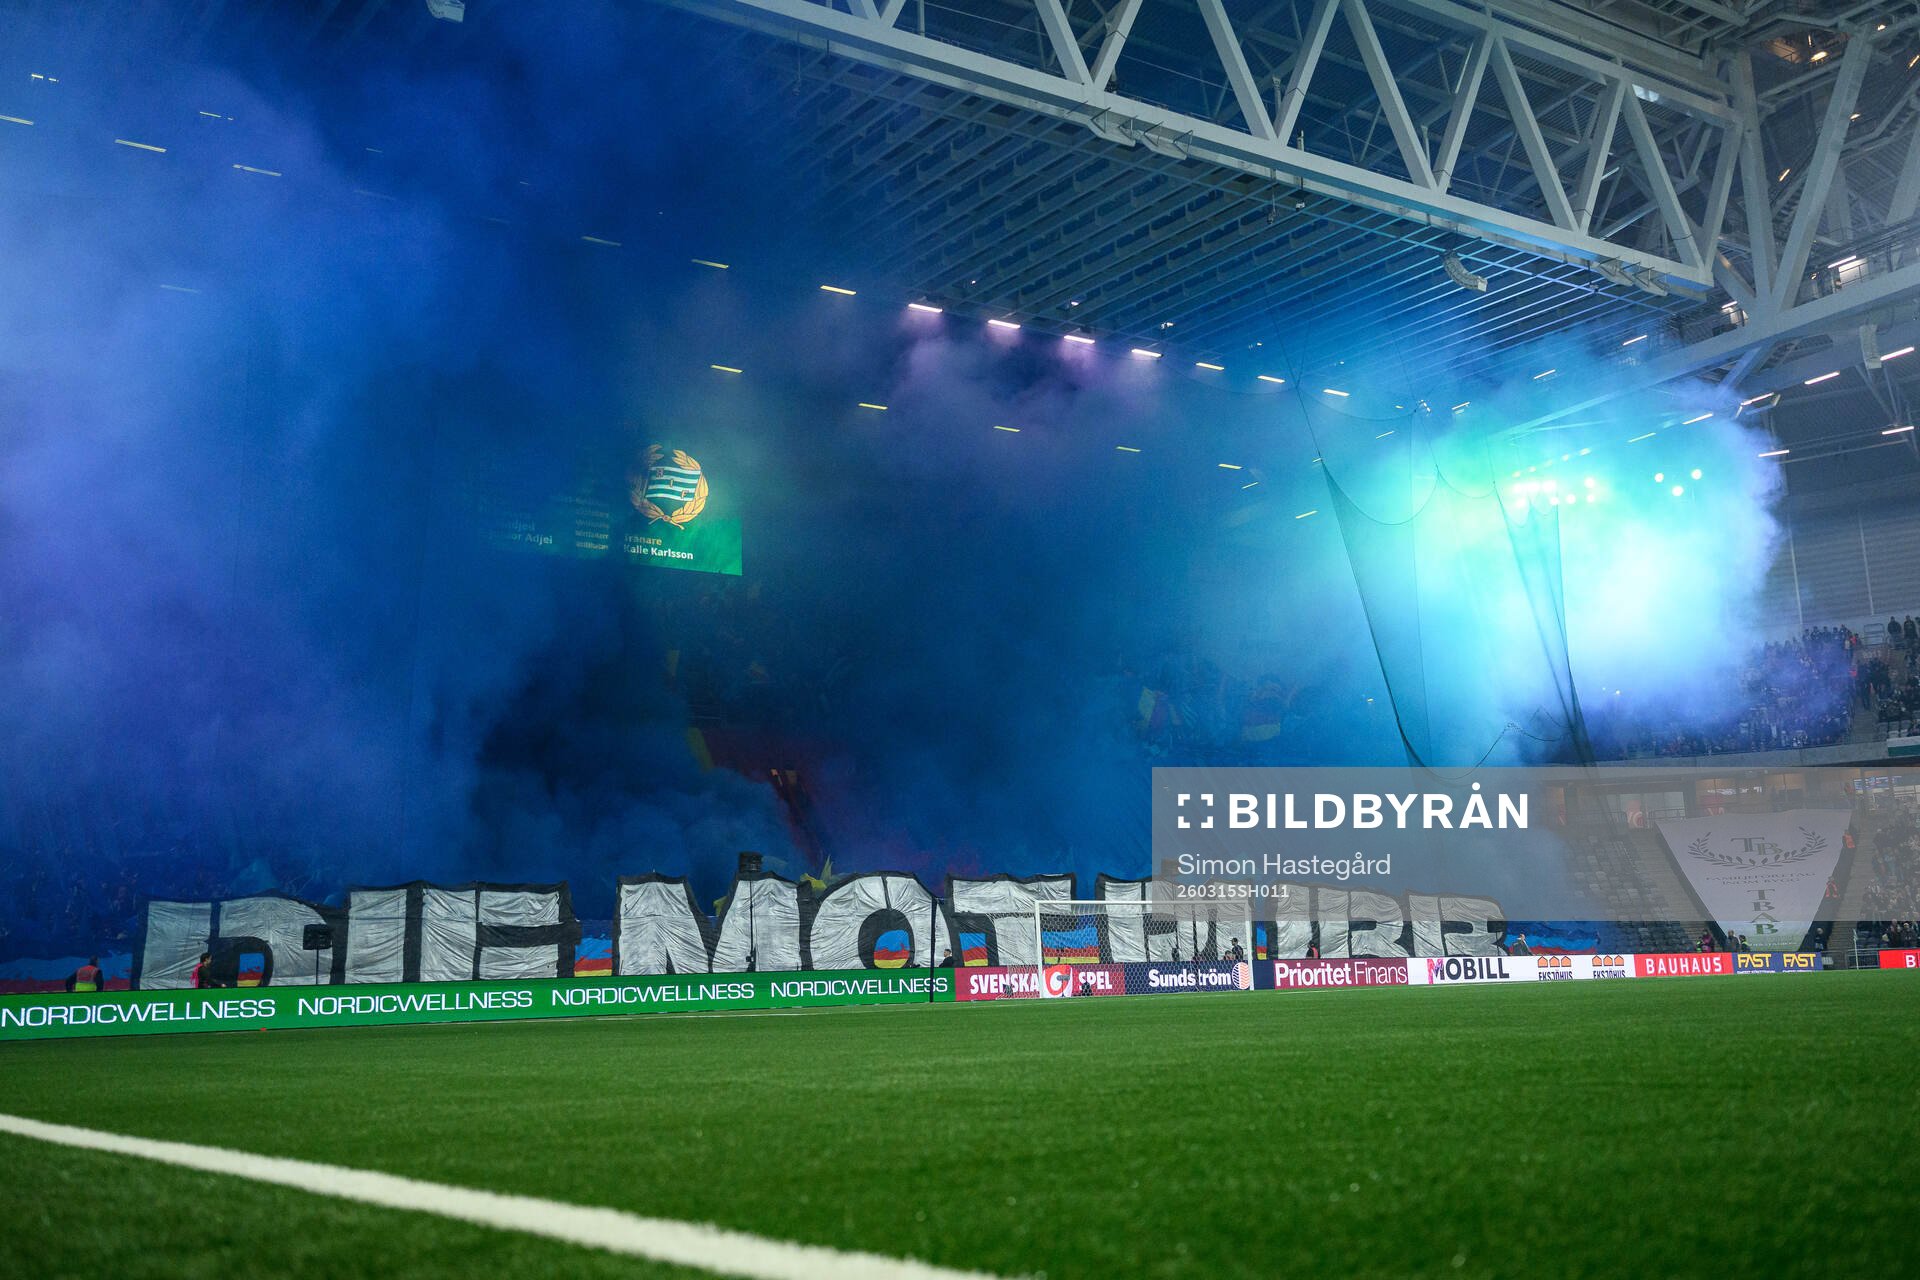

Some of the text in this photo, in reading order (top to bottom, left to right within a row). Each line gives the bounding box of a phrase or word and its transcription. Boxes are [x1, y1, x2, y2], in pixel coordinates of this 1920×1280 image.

[651, 547, 694, 560] Karlsson
[1645, 956, 1723, 974] BAUHAUS
[1737, 953, 1772, 968] FAST
[1783, 953, 1816, 968] FAST
[1148, 968, 1231, 987] Sundström
[1275, 961, 1407, 987] Prioritet Finans
[1427, 957, 1510, 985] MOBILL
[970, 971, 1112, 994] SVENSKA SPEL
[1, 978, 948, 1027] NORDICWELLNESS NORDICWELLNESS NORDICWELLNESS NORDICWELLNESS
